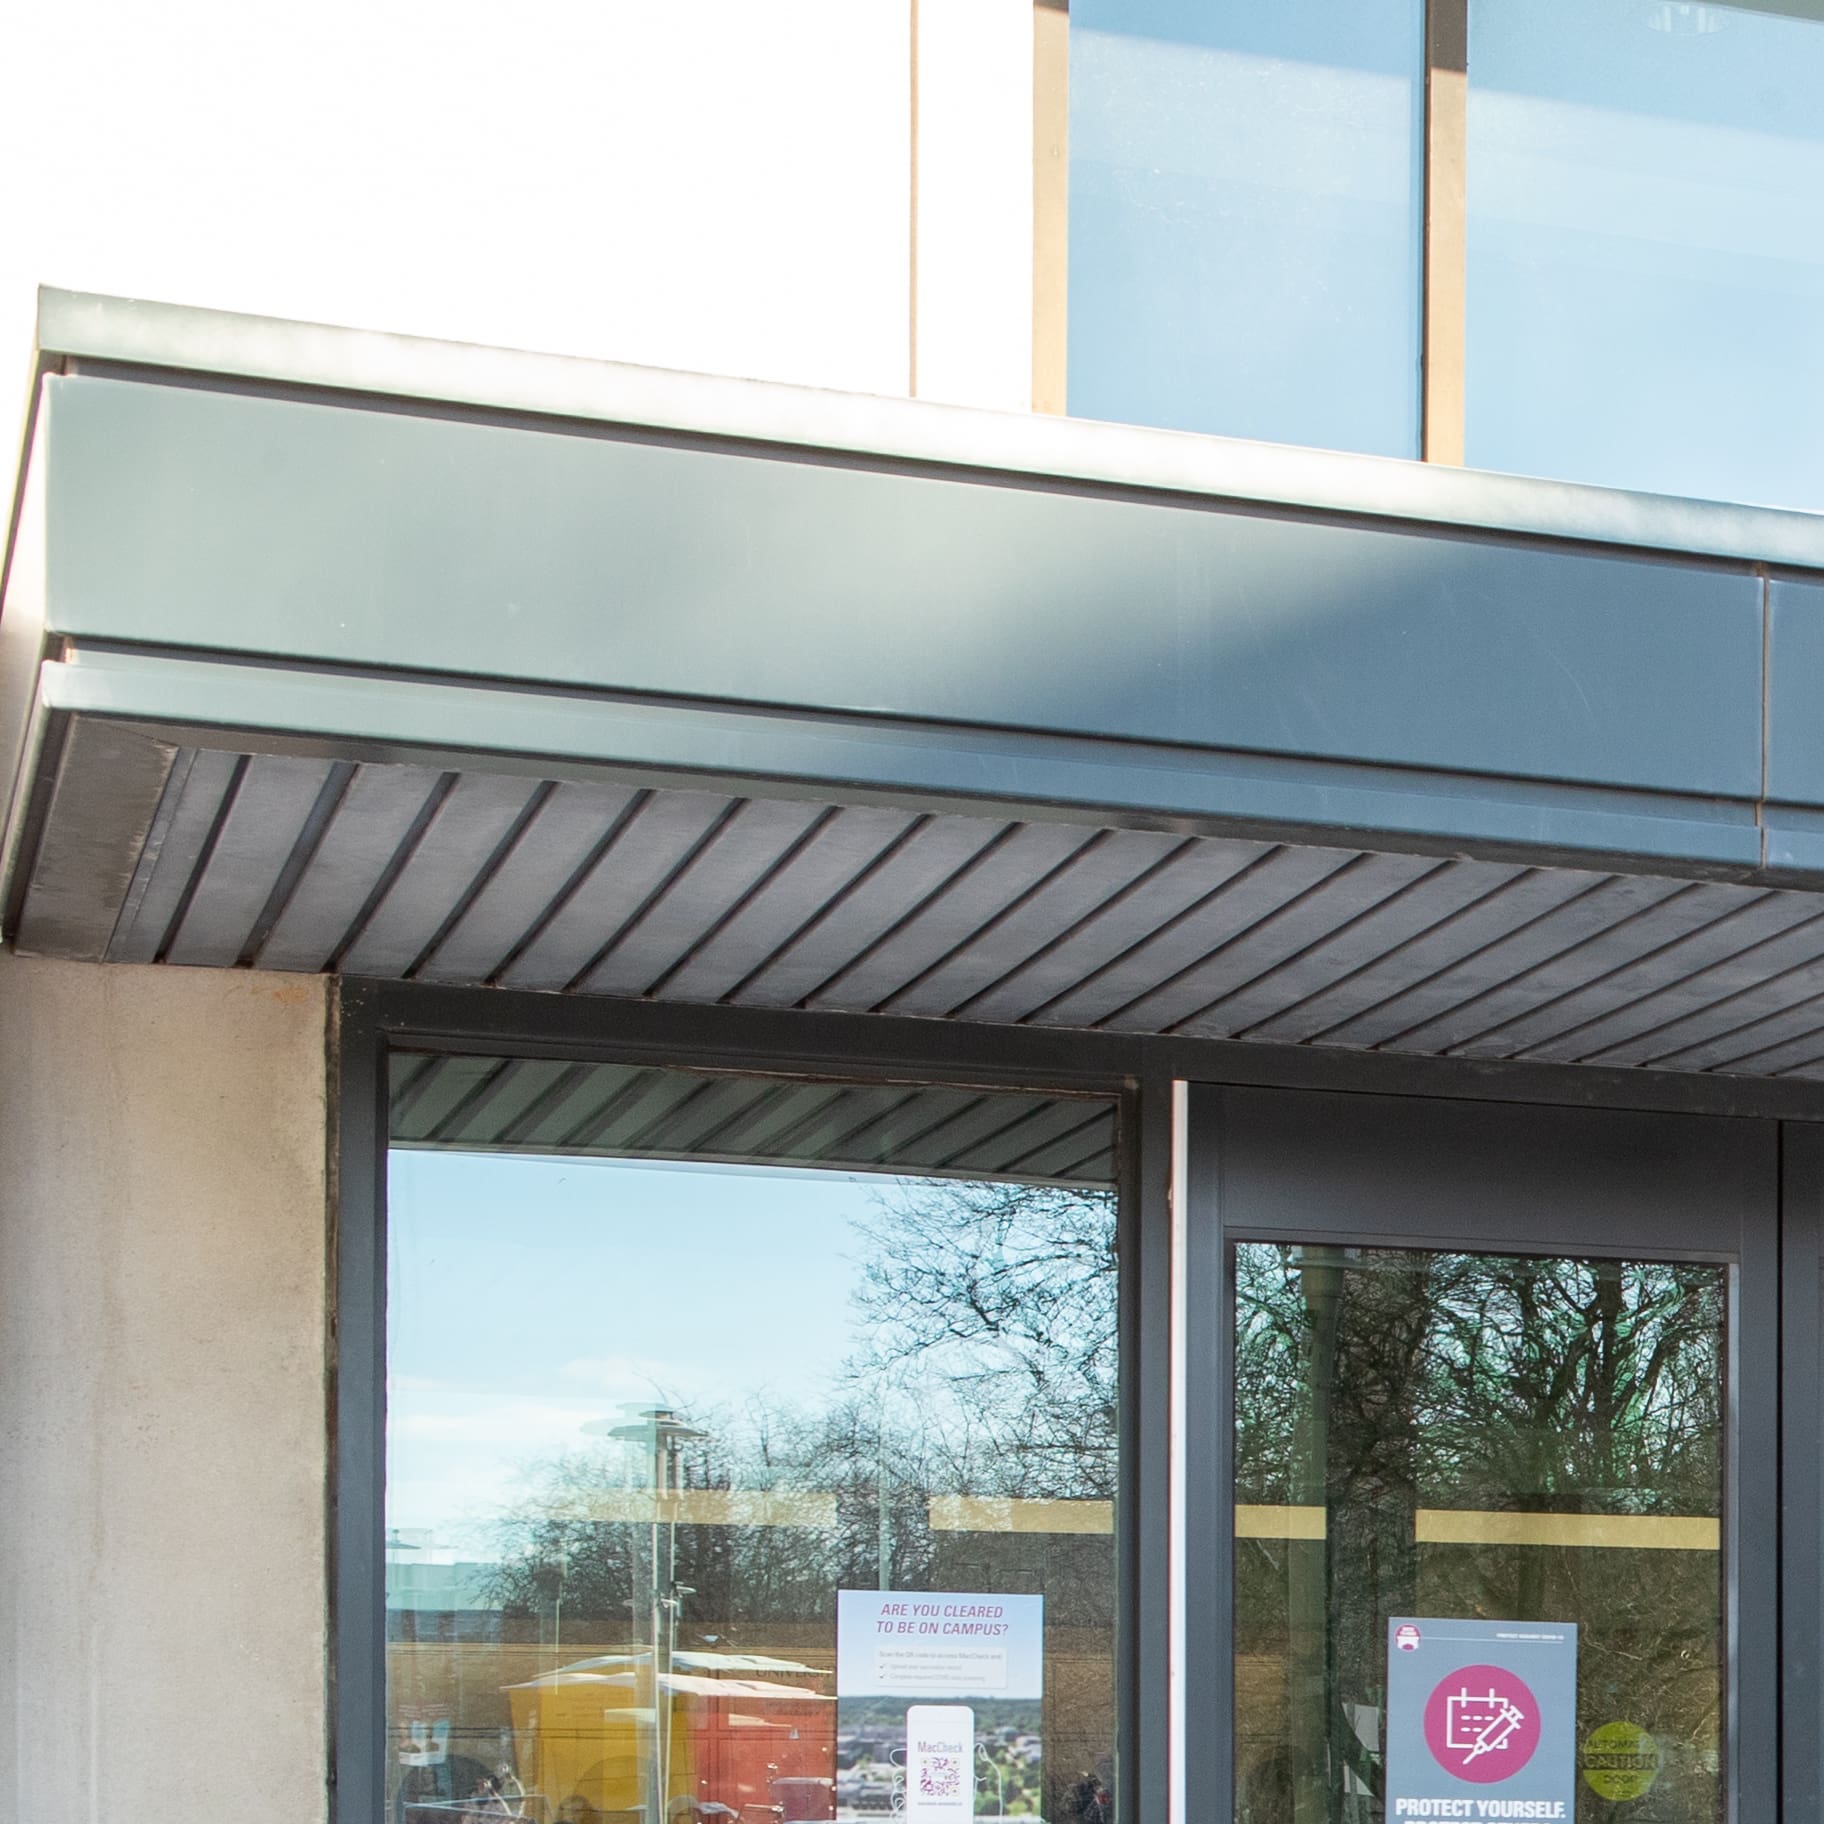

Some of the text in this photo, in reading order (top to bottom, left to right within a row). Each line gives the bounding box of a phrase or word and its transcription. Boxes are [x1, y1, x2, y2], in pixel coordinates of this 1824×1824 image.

[881, 1603, 1004, 1618] ARE YOU CLEARED
[877, 1620, 1009, 1636] TO BE ON CAMPUS?
[917, 1741, 963, 1753] MacCheck
[1585, 1754, 1656, 1769] CAUTION
[1395, 1798, 1567, 1819] PROTECT YOURSELF.
